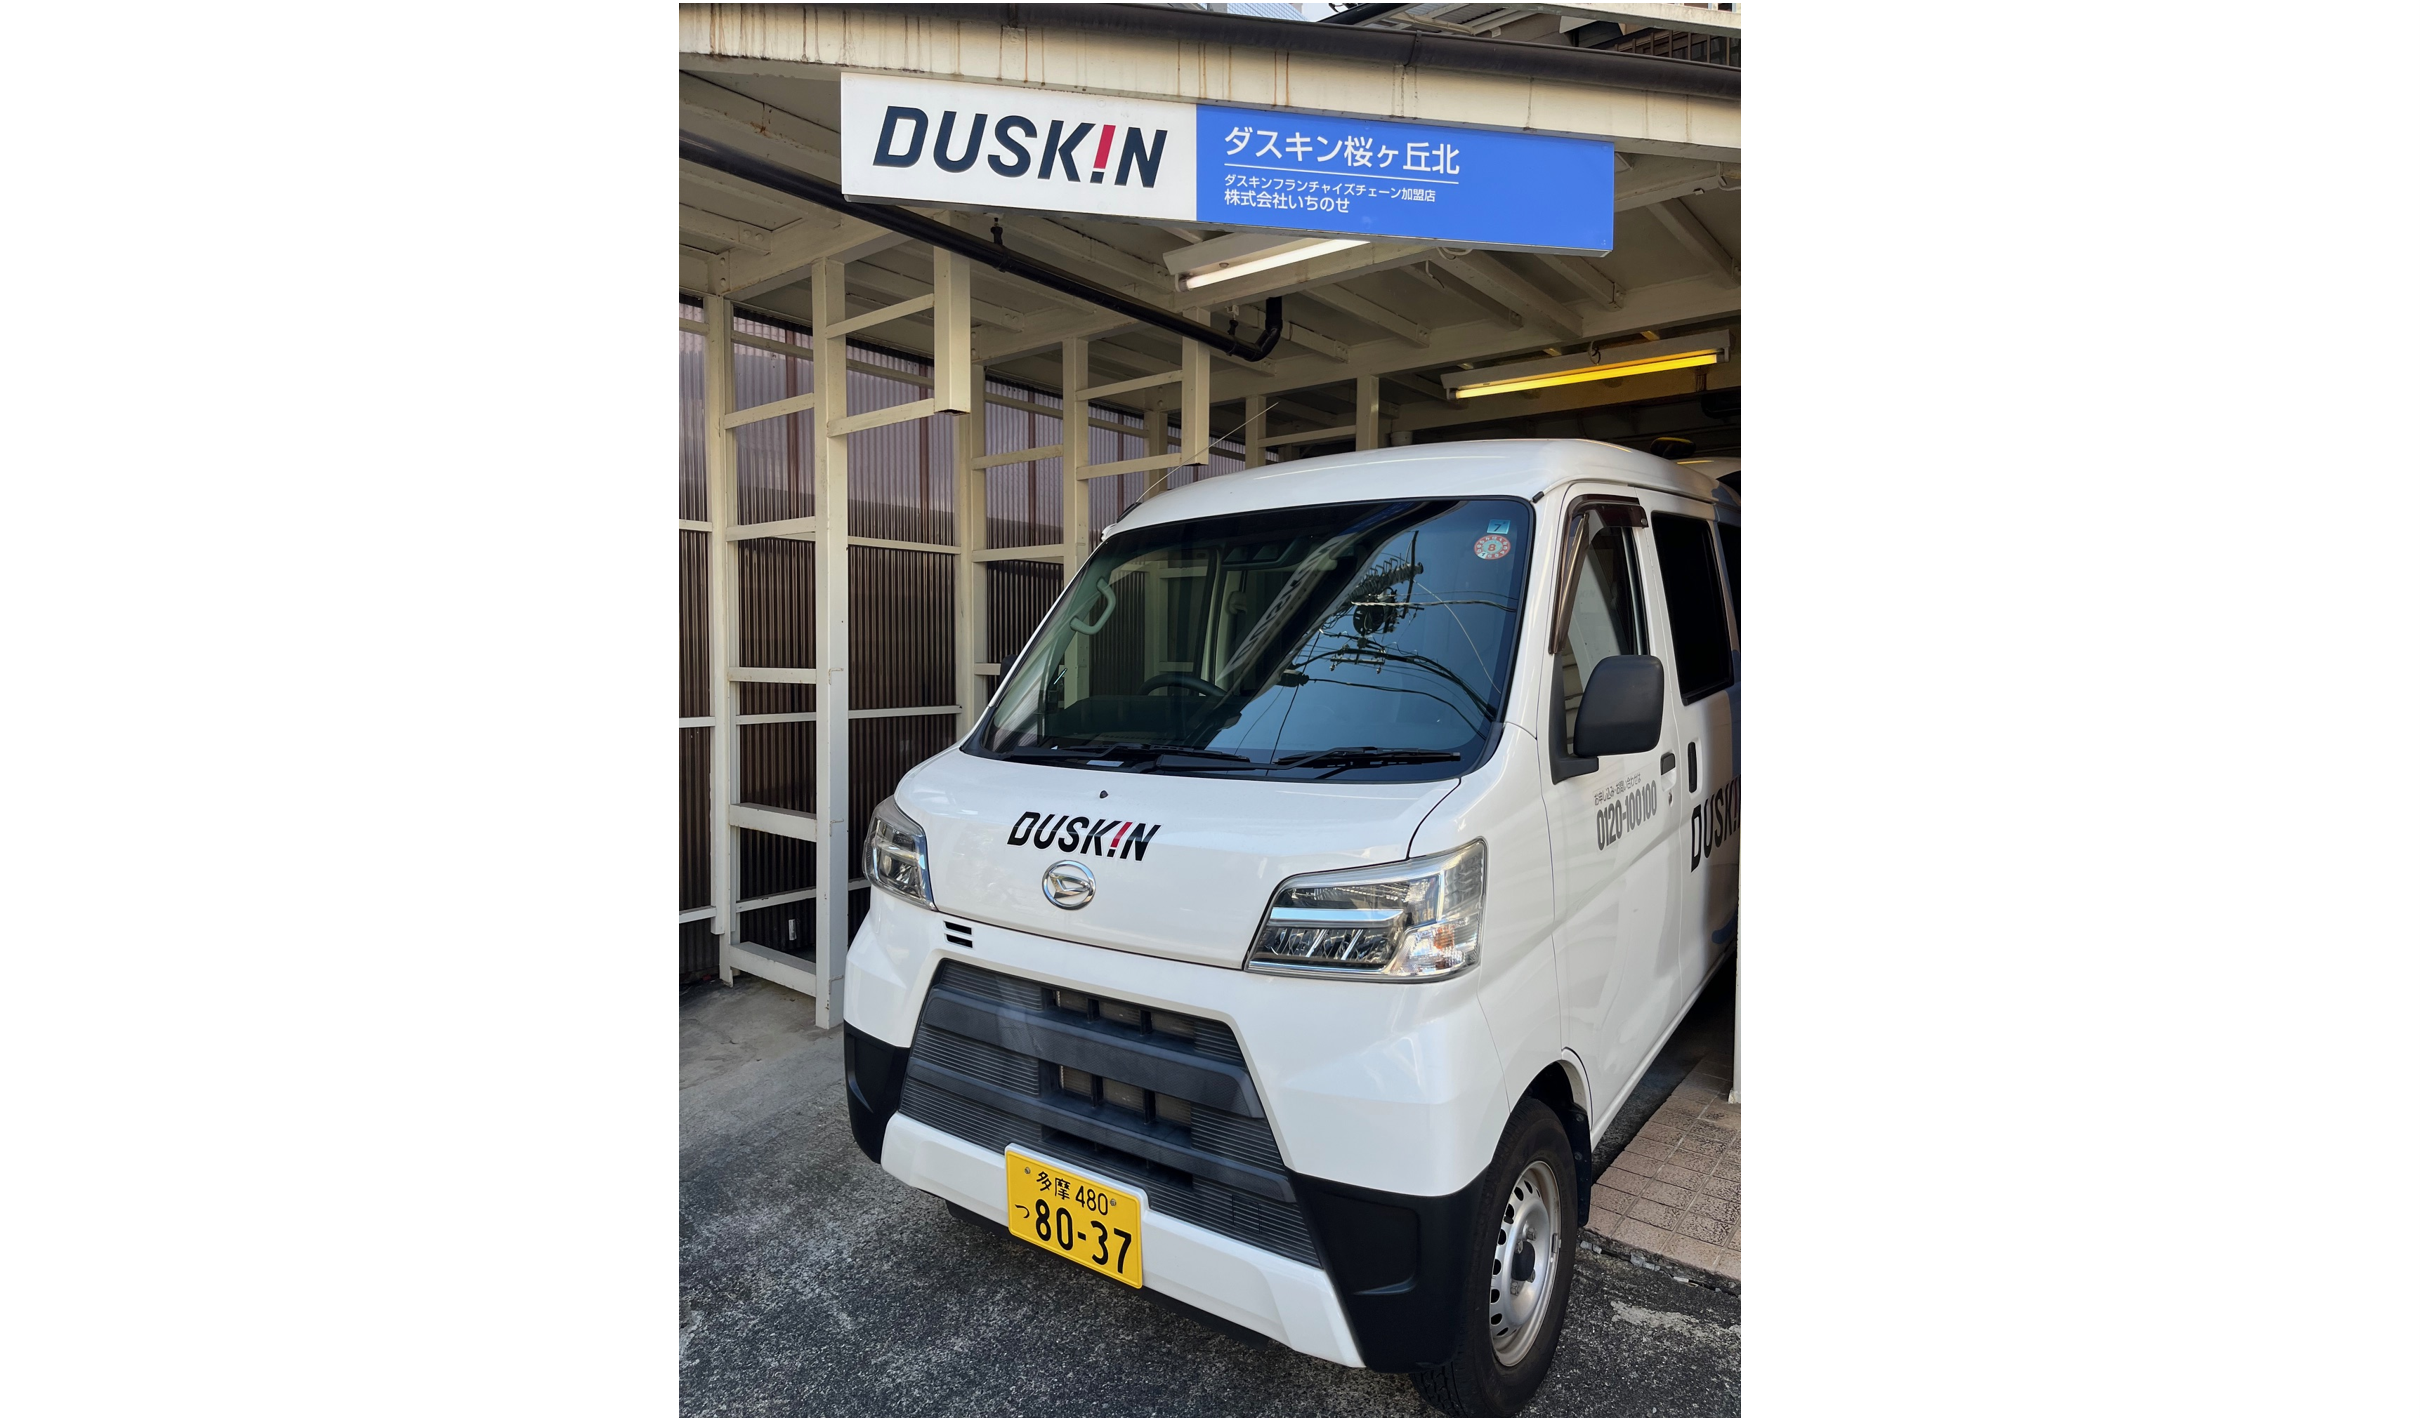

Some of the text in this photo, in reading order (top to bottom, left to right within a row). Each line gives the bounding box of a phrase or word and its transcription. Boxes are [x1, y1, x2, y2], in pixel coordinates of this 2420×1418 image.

[1224, 126, 1460, 175] ダスキン桜ヶ丘北
[1224, 173, 1436, 202] ダスキンフランチャイズチェーン加盟店
[1224, 188, 1350, 213] 株式会社いちのせ
[1036, 1171, 1108, 1216] 多摩 480
[1014, 1198, 1132, 1274] つ 80-37
